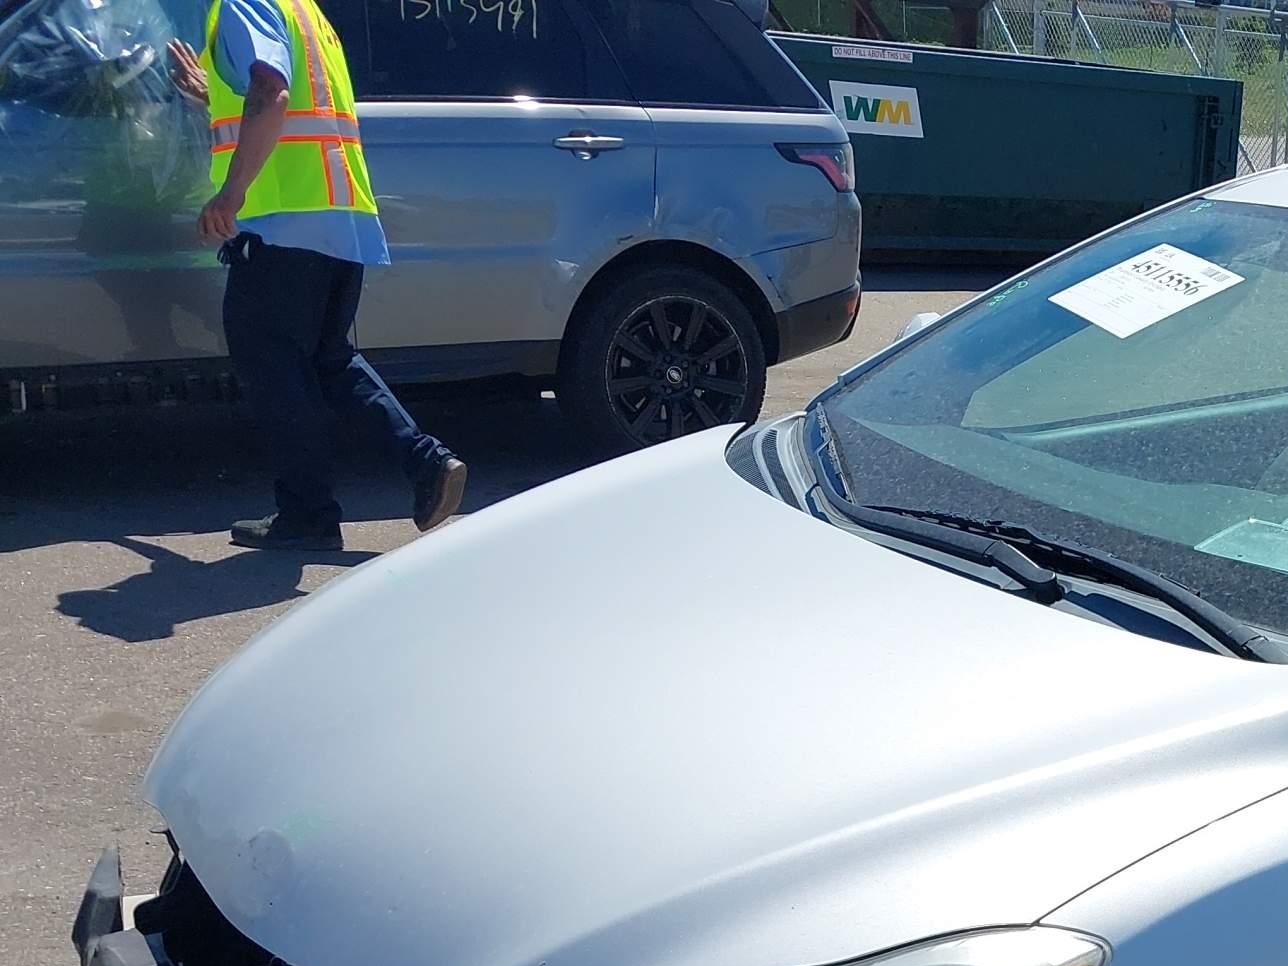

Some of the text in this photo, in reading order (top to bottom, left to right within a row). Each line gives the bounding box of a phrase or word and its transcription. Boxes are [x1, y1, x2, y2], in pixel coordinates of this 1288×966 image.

[834, 47, 911, 60] DO NOT FILL ABOVE THIS LINE
[843, 95, 913, 125] WM
[1131, 260, 1208, 296] 45115556
